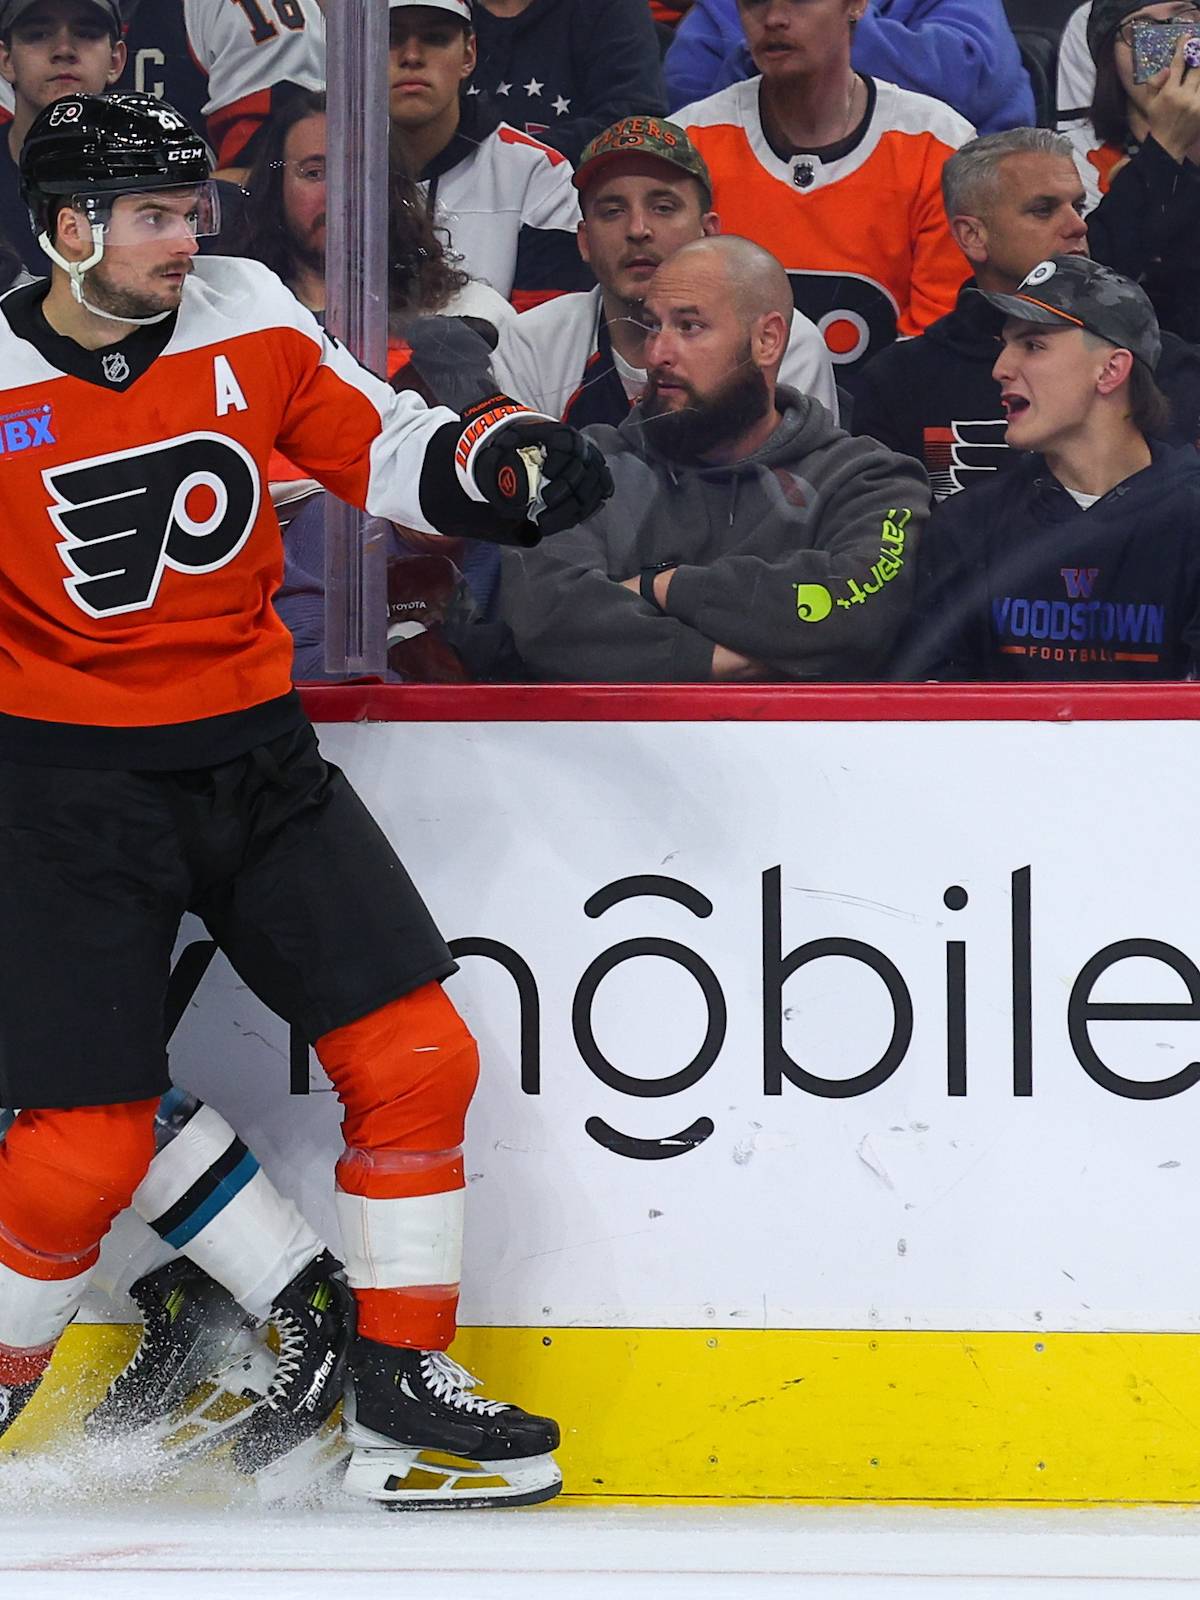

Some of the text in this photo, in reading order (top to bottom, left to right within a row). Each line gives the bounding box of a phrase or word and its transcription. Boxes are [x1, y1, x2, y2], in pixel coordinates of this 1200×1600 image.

[135, 48, 165, 100] C
[168, 149, 202, 161] CCM
[591, 119, 677, 156] FLYERS
[213, 354, 249, 417] A
[836, 508, 913, 610] carhartt
[1061, 568, 1099, 598] W
[392, 601, 427, 612] TOYOTA
